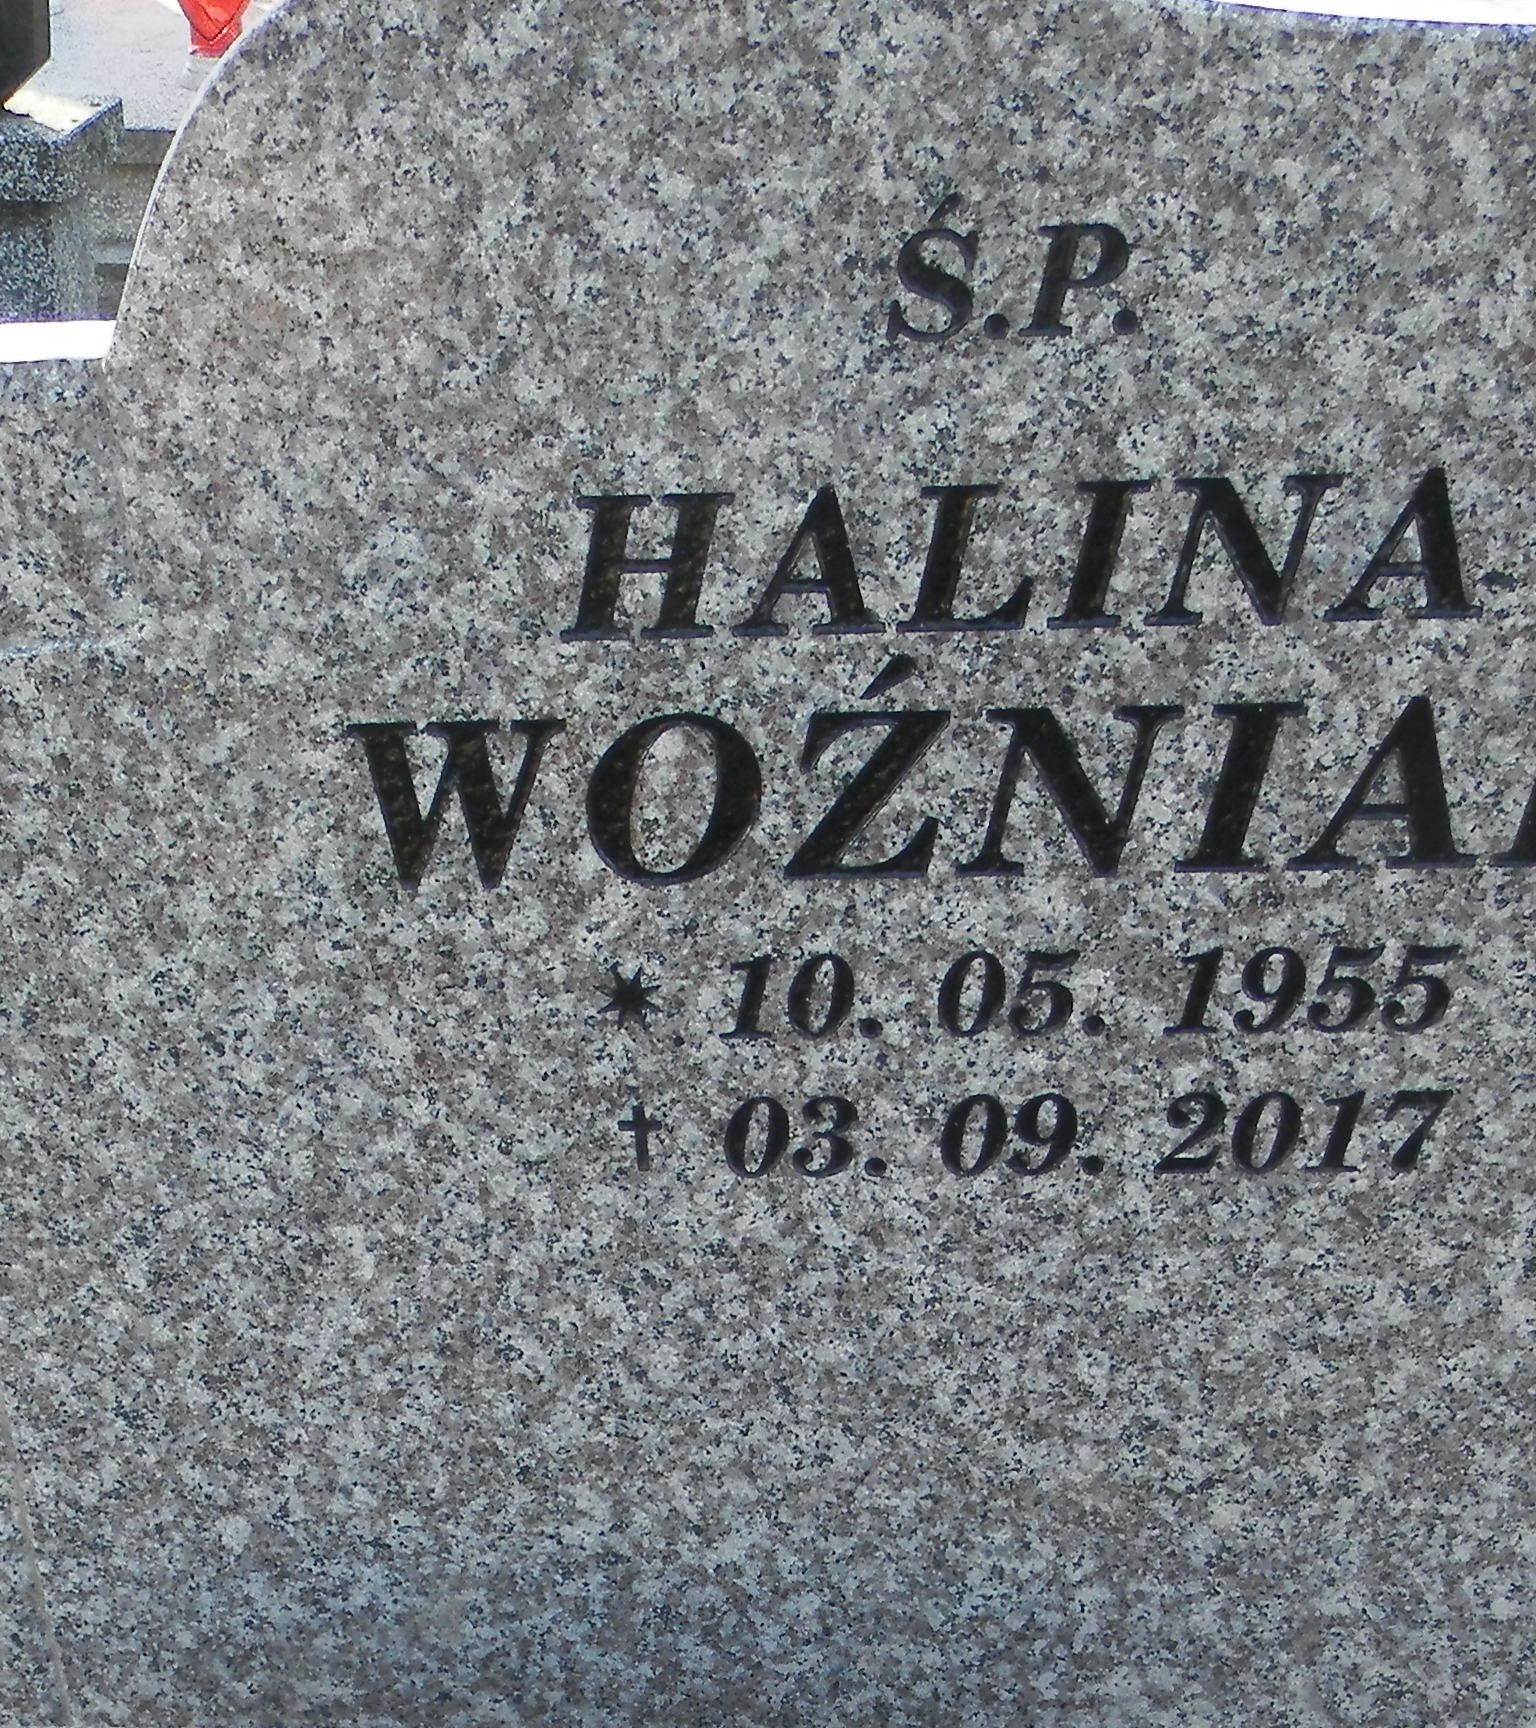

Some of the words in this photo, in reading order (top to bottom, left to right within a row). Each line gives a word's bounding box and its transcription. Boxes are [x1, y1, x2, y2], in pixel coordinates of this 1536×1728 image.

[885, 200, 1138, 341] Ś.P.
[559, 465, 1483, 641] HALINA
[720, 950, 883, 1039] 10.
[936, 948, 1105, 1037] 05.
[1163, 942, 1462, 1035] 1955
[723, 1094, 885, 1177] 03.
[939, 1090, 1105, 1178] 09.
[1153, 1088, 1453, 1175] 2017
